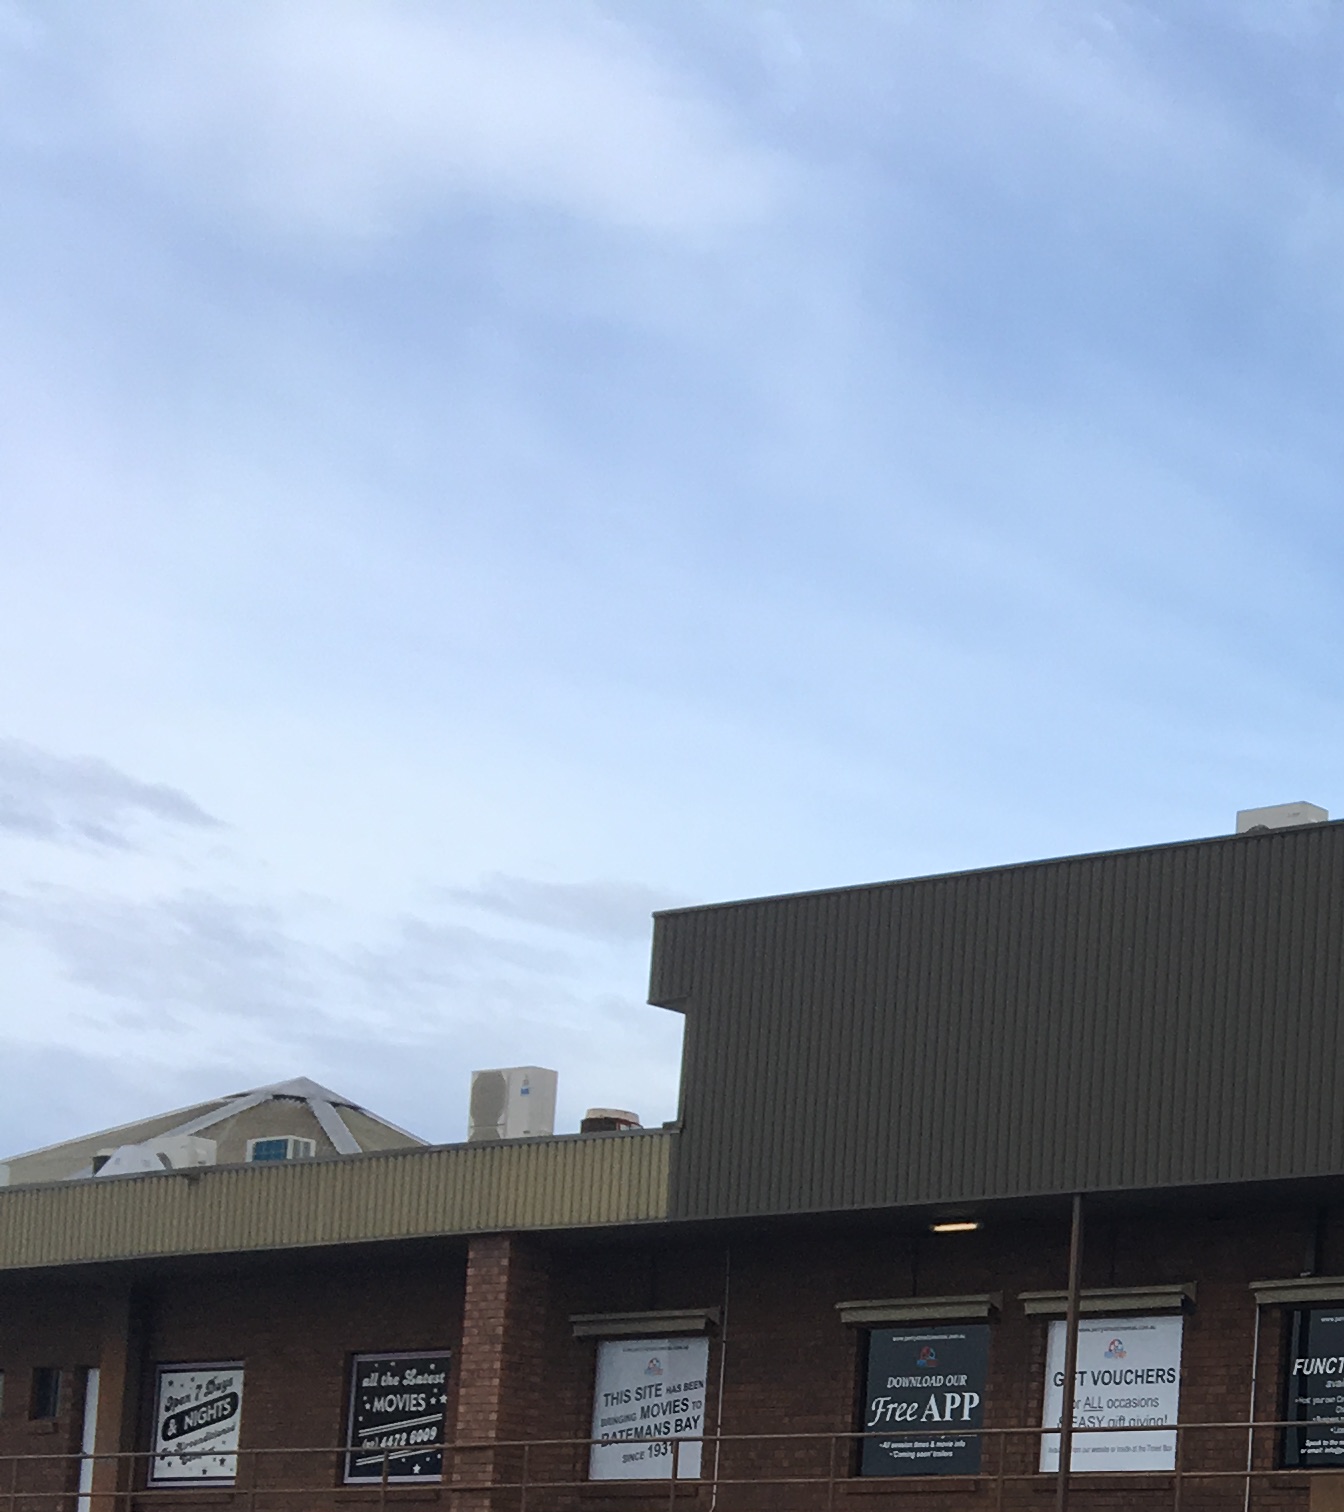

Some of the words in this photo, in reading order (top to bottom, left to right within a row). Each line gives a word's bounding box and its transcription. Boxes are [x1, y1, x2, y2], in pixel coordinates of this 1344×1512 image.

[381, 1371, 399, 1386] the
[887, 1375, 943, 1388] DOWNLOAD
[946, 1374, 967, 1387] OUR
[1053, 1370, 1087, 1387] GT
[1091, 1368, 1176, 1386] VOUCHERS
[373, 1393, 426, 1412] MOVIES
[603, 1388, 631, 1407] THIS
[635, 1382, 662, 1401] SITE
[666, 1383, 681, 1394] HAS
[683, 1380, 704, 1391] BEEN
[1083, 1396, 1103, 1410] ALL
[1106, 1396, 1160, 1408] occasions
[168, 1419, 177, 1436] &
[184, 1398, 231, 1430] NIGHTS
[640, 1397, 689, 1420] MOVIES
[692, 1400, 702, 1410] TO
[867, 1396, 918, 1426] Free
[920, 1392, 980, 1422] APP
[601, 1420, 671, 1447] BATEMANS
[674, 1415, 700, 1433] BAY
[622, 1451, 645, 1463] SINCE
